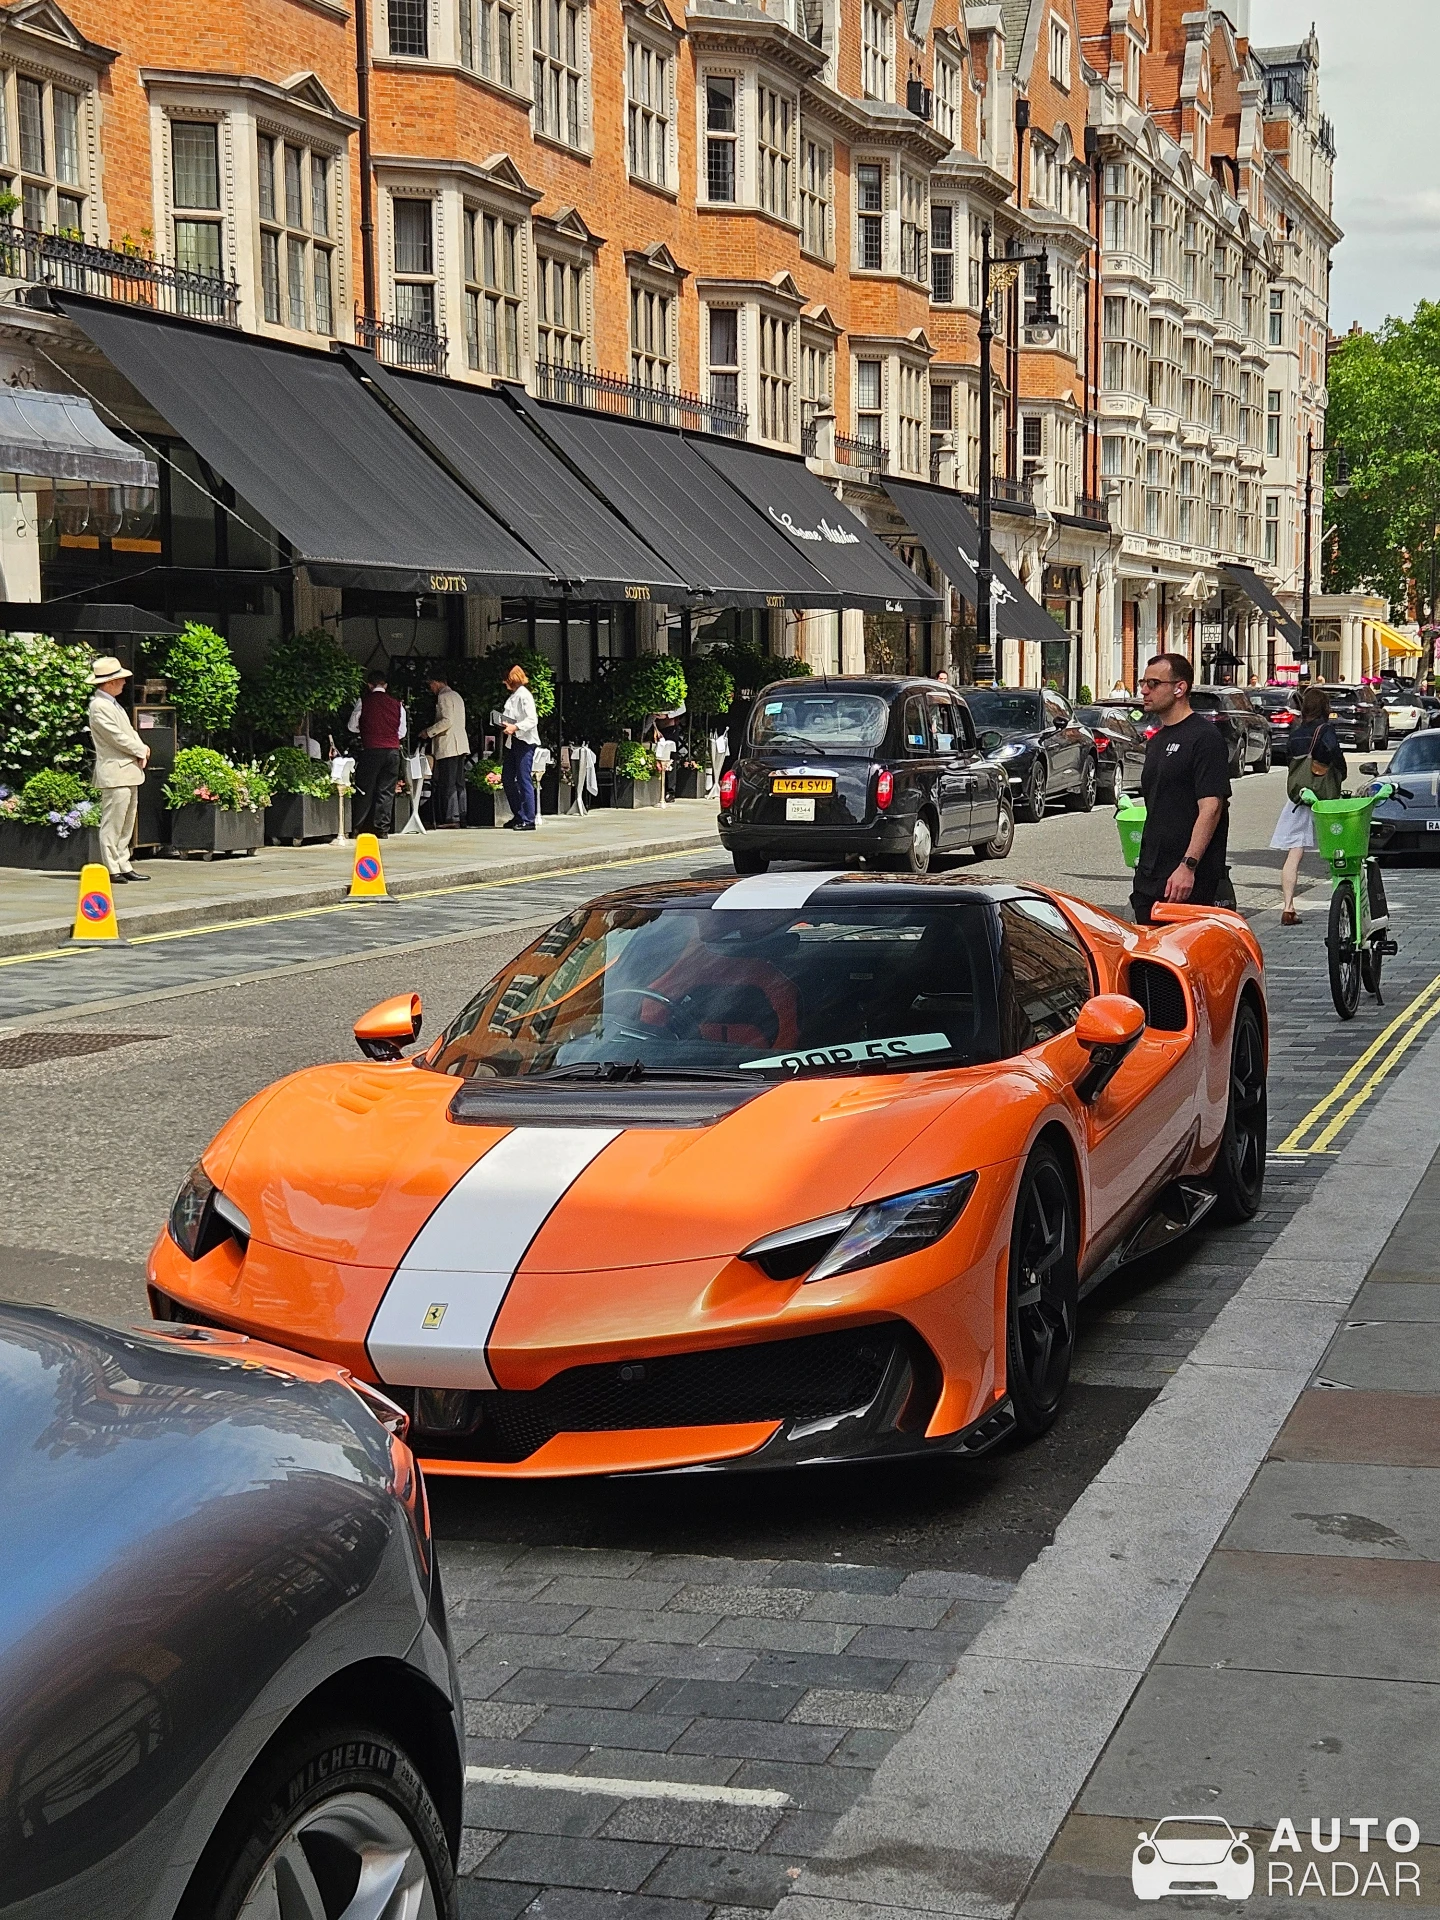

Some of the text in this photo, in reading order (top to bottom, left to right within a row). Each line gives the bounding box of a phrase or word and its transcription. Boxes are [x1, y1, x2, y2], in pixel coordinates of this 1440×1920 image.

[430, 574, 468, 592] SCOTT'S
[777, 780, 828, 791] LY64 SYU
[1428, 821, 1440, 830] RA
[288, 1743, 392, 1807] MICHELIN
